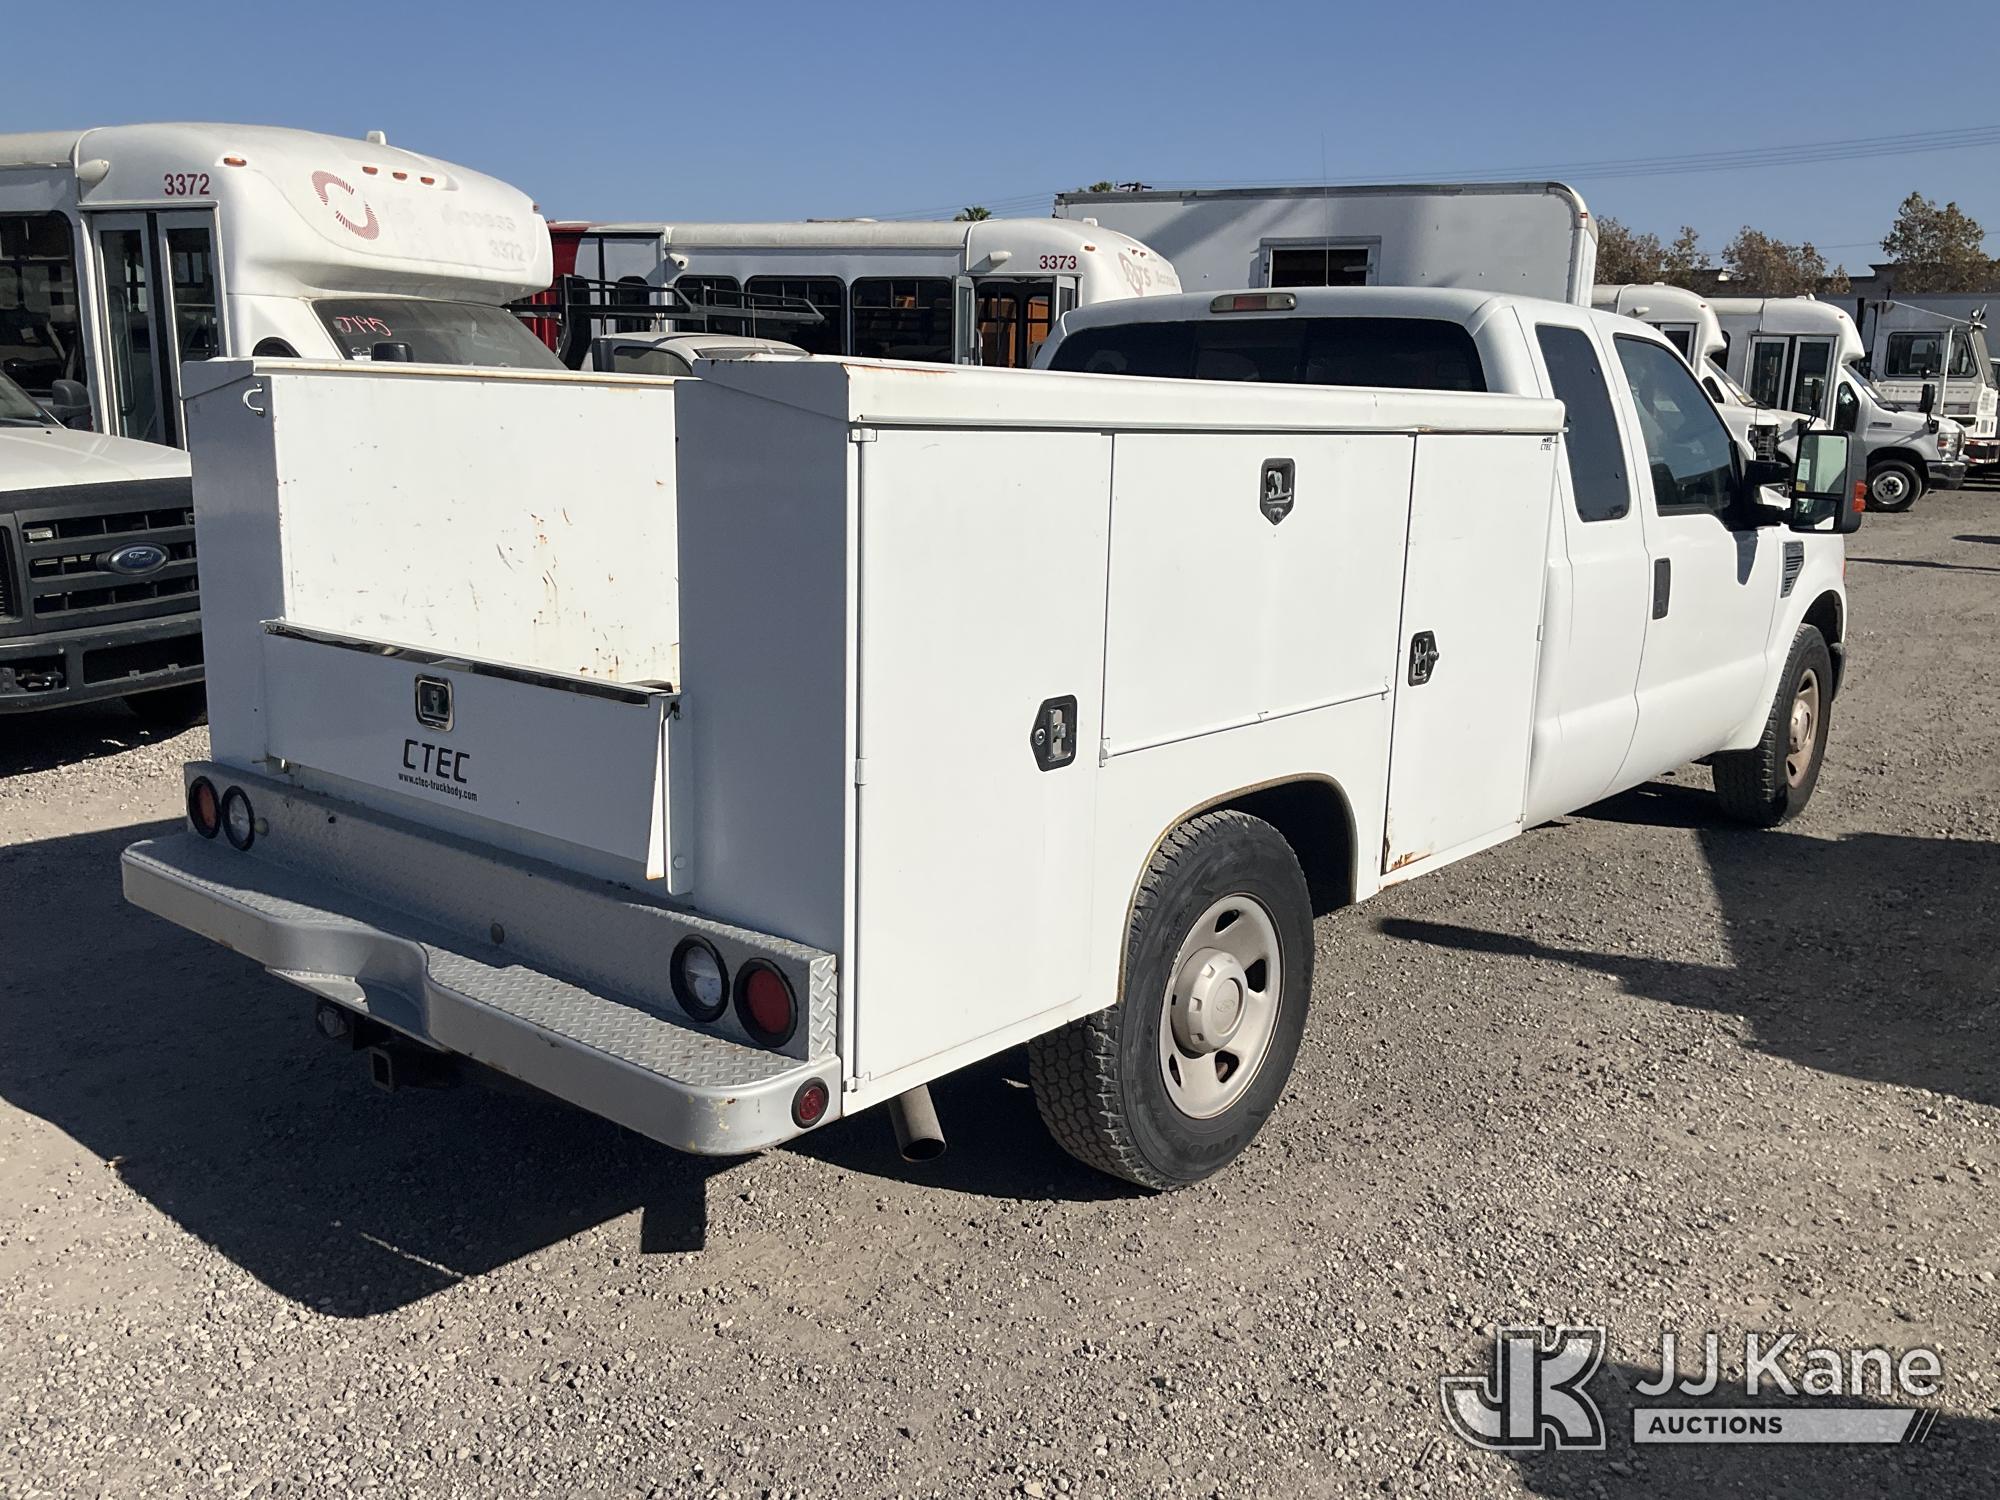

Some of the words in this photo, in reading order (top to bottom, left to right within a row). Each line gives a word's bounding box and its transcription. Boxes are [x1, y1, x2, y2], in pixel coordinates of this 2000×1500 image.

[164, 173, 210, 196] 3372
[1039, 255, 1077, 270] 3373
[403, 738, 470, 784] CTEC
[398, 772, 478, 802] www.ctec-truckbody.com
